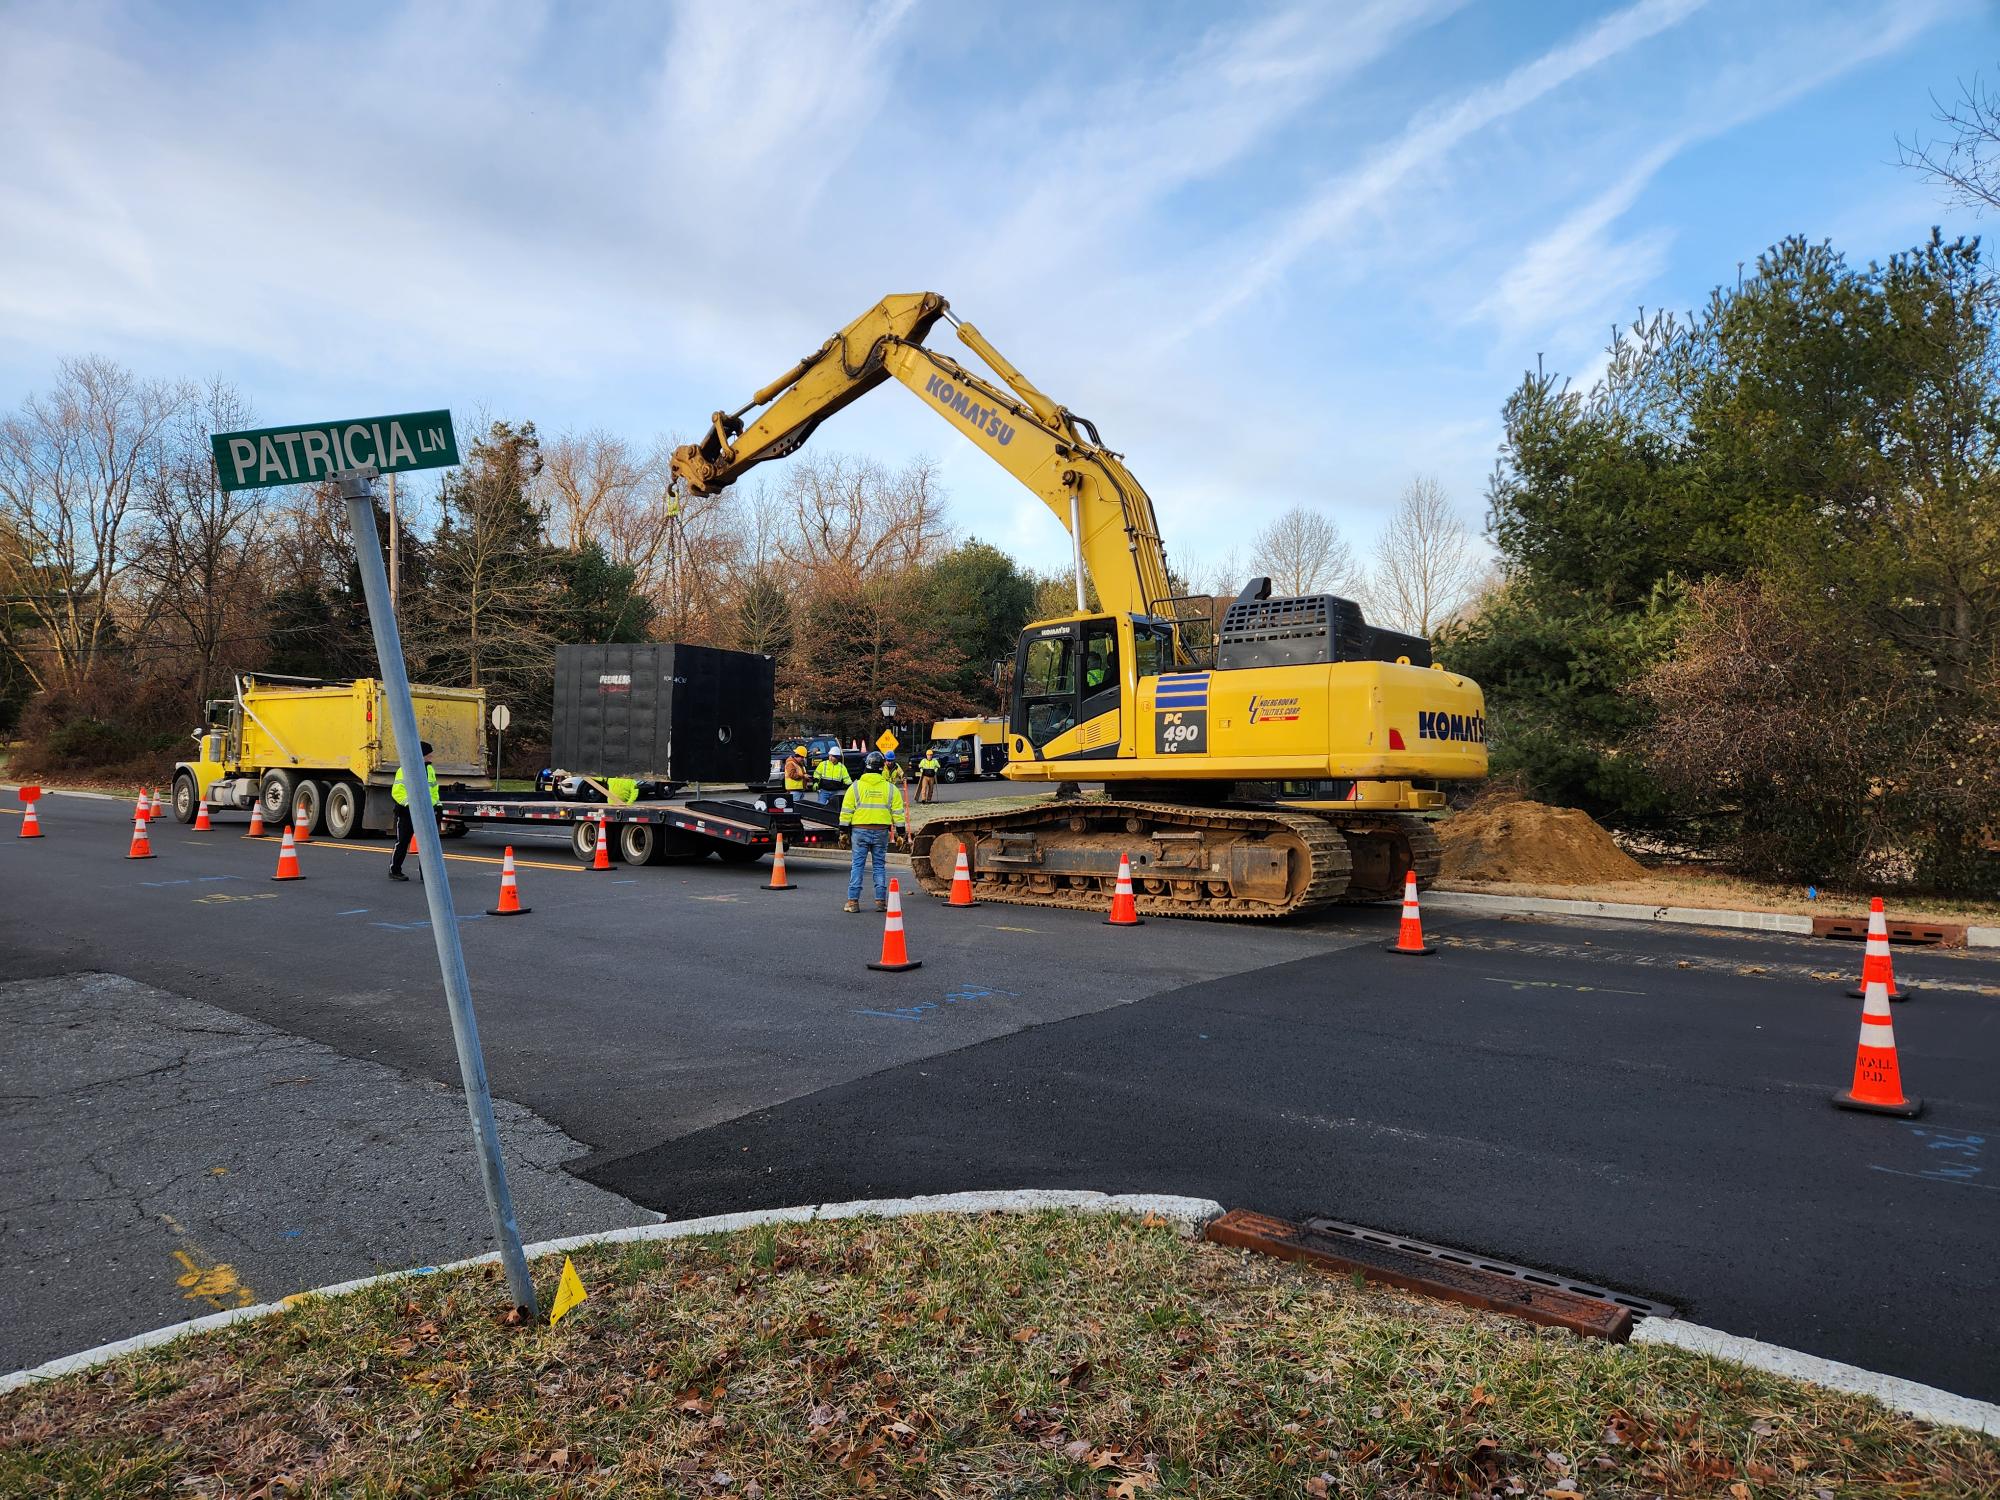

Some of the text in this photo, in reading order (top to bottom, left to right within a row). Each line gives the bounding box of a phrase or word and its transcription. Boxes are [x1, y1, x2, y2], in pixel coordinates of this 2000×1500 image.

[925, 373, 1016, 446] KOMATSU
[228, 421, 447, 485] PATRICIA LN
[1041, 626, 1070, 636] KOMATSU
[1163, 712, 1183, 725] PC
[1163, 725, 1199, 742] 490
[1164, 742, 1178, 752] LC
